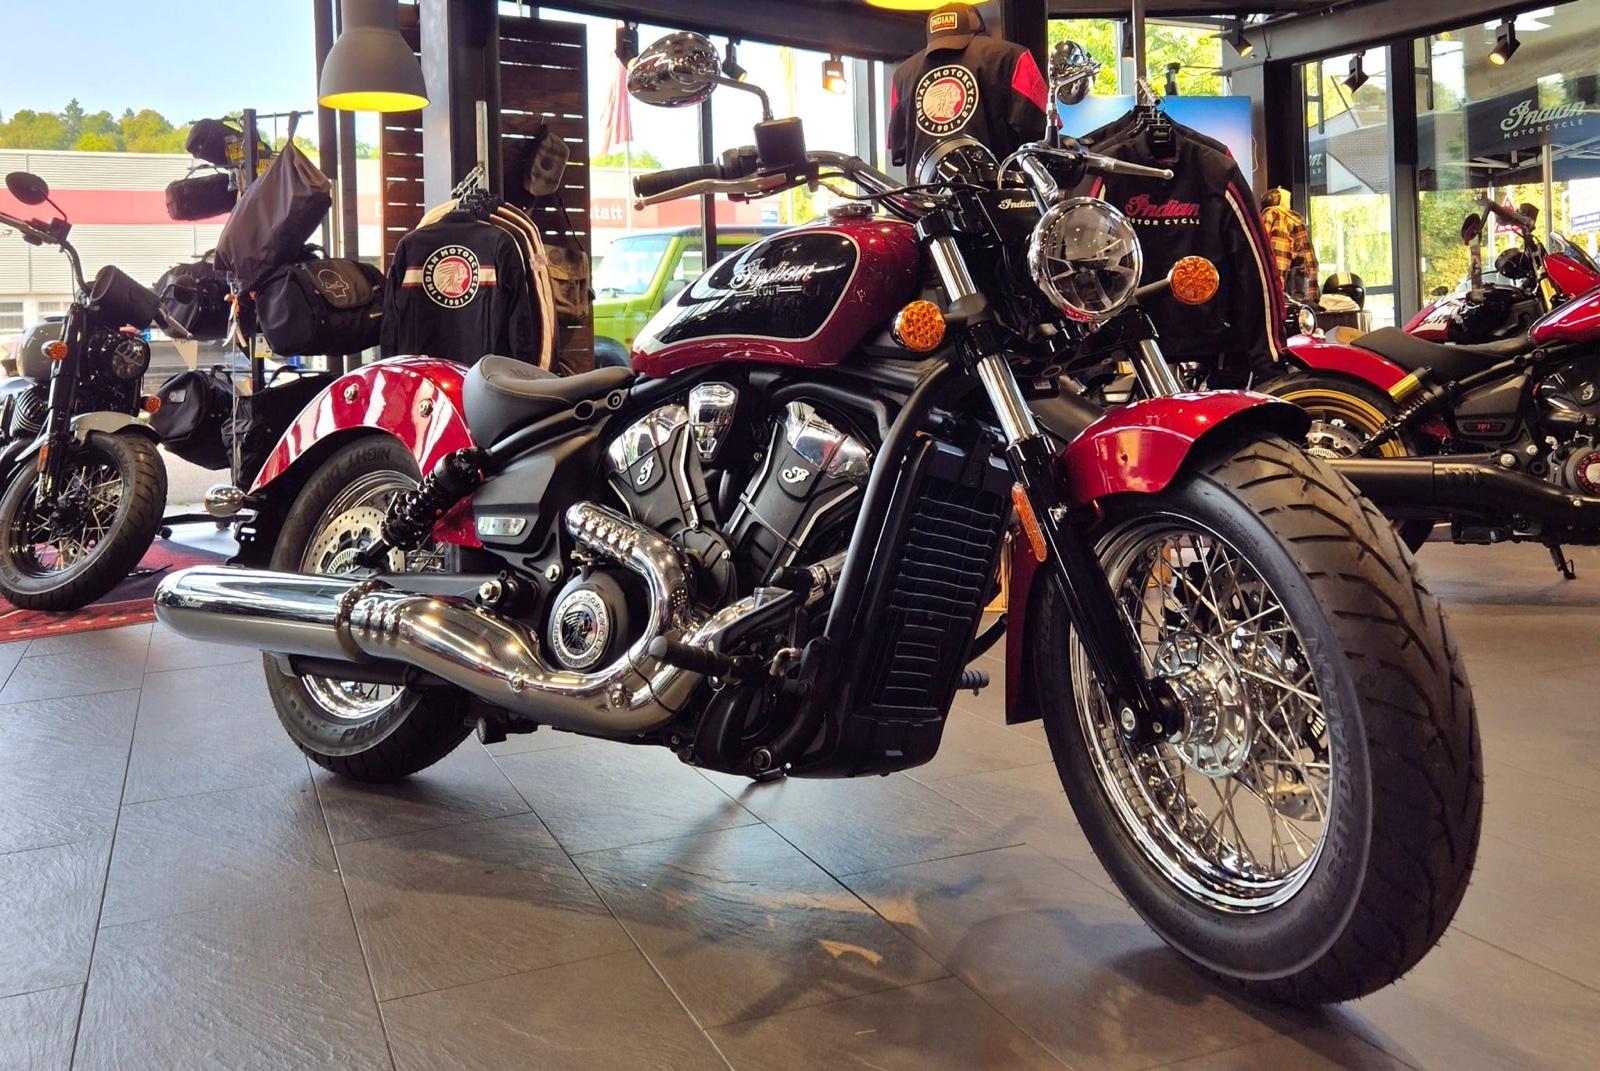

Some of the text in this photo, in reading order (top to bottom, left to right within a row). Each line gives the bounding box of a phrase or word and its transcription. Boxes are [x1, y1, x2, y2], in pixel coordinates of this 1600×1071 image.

[930, 15, 955, 26] INDIAN
[916, 68, 975, 122] INDIAN MOTORCYCLE
[930, 122, 954, 131] 1901
[1500, 99, 1585, 131] Indian
[1503, 118, 1584, 139] MOTORCYCLE
[998, 198, 1038, 210] Indian
[1125, 192, 1200, 218] Indian
[425, 247, 478, 296] INDIAN MOTORCYCLE
[729, 258, 844, 289] Indian
[444, 298, 464, 306] 1901
